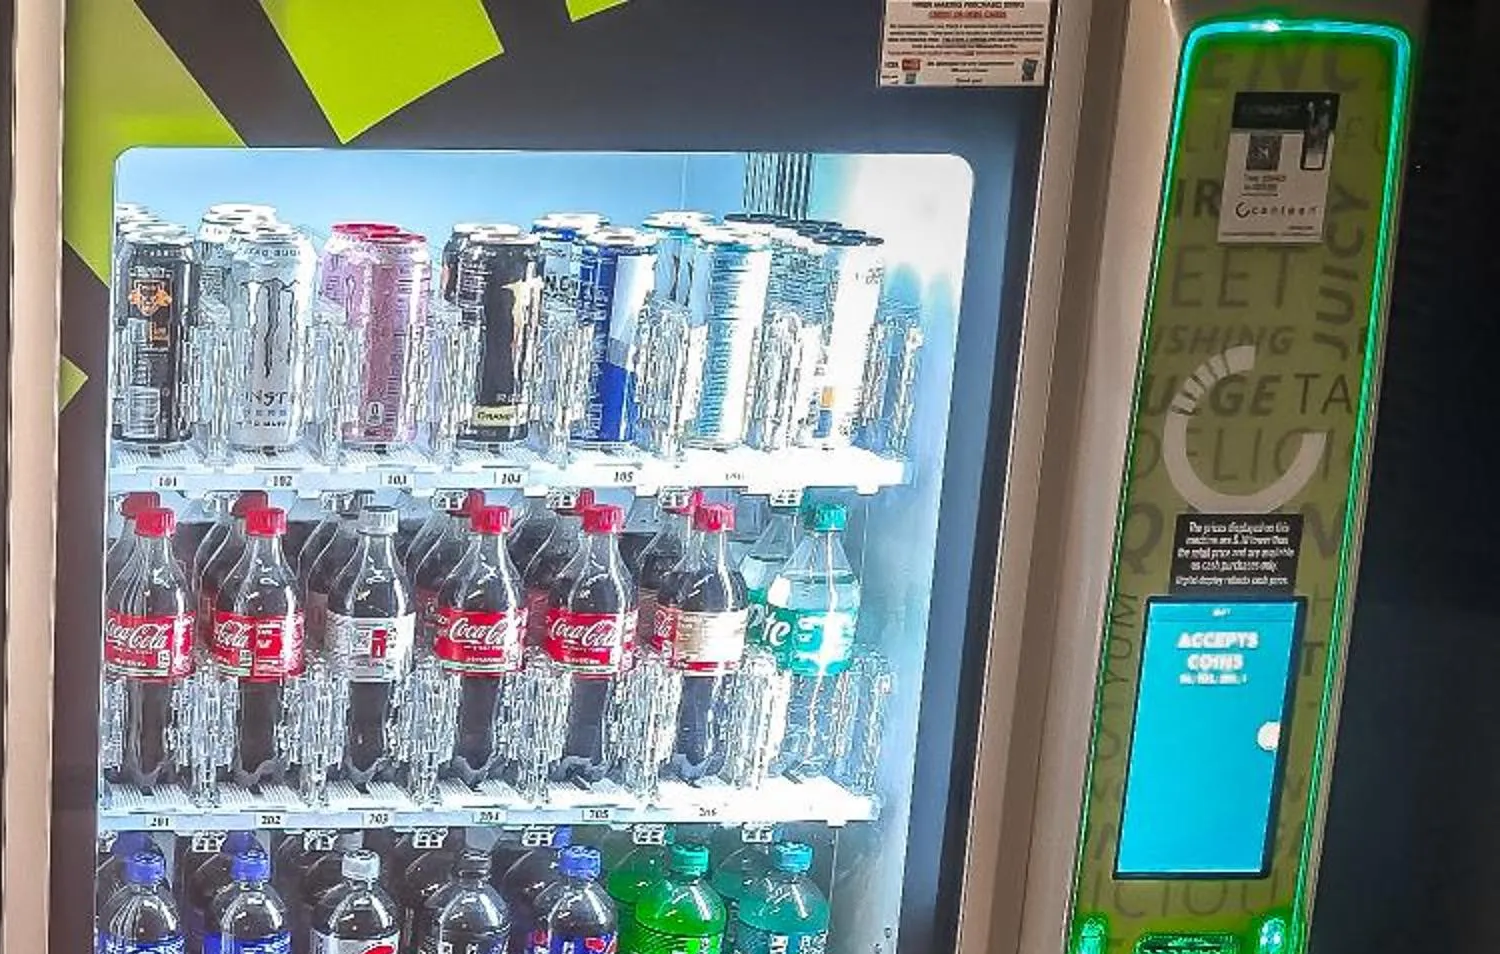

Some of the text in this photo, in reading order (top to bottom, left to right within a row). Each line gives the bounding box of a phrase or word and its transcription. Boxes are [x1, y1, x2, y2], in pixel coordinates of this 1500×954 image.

[501, 472, 521, 484] 104
[613, 471, 633, 483] 105
[1177, 630, 1259, 649] ACCEPTS
